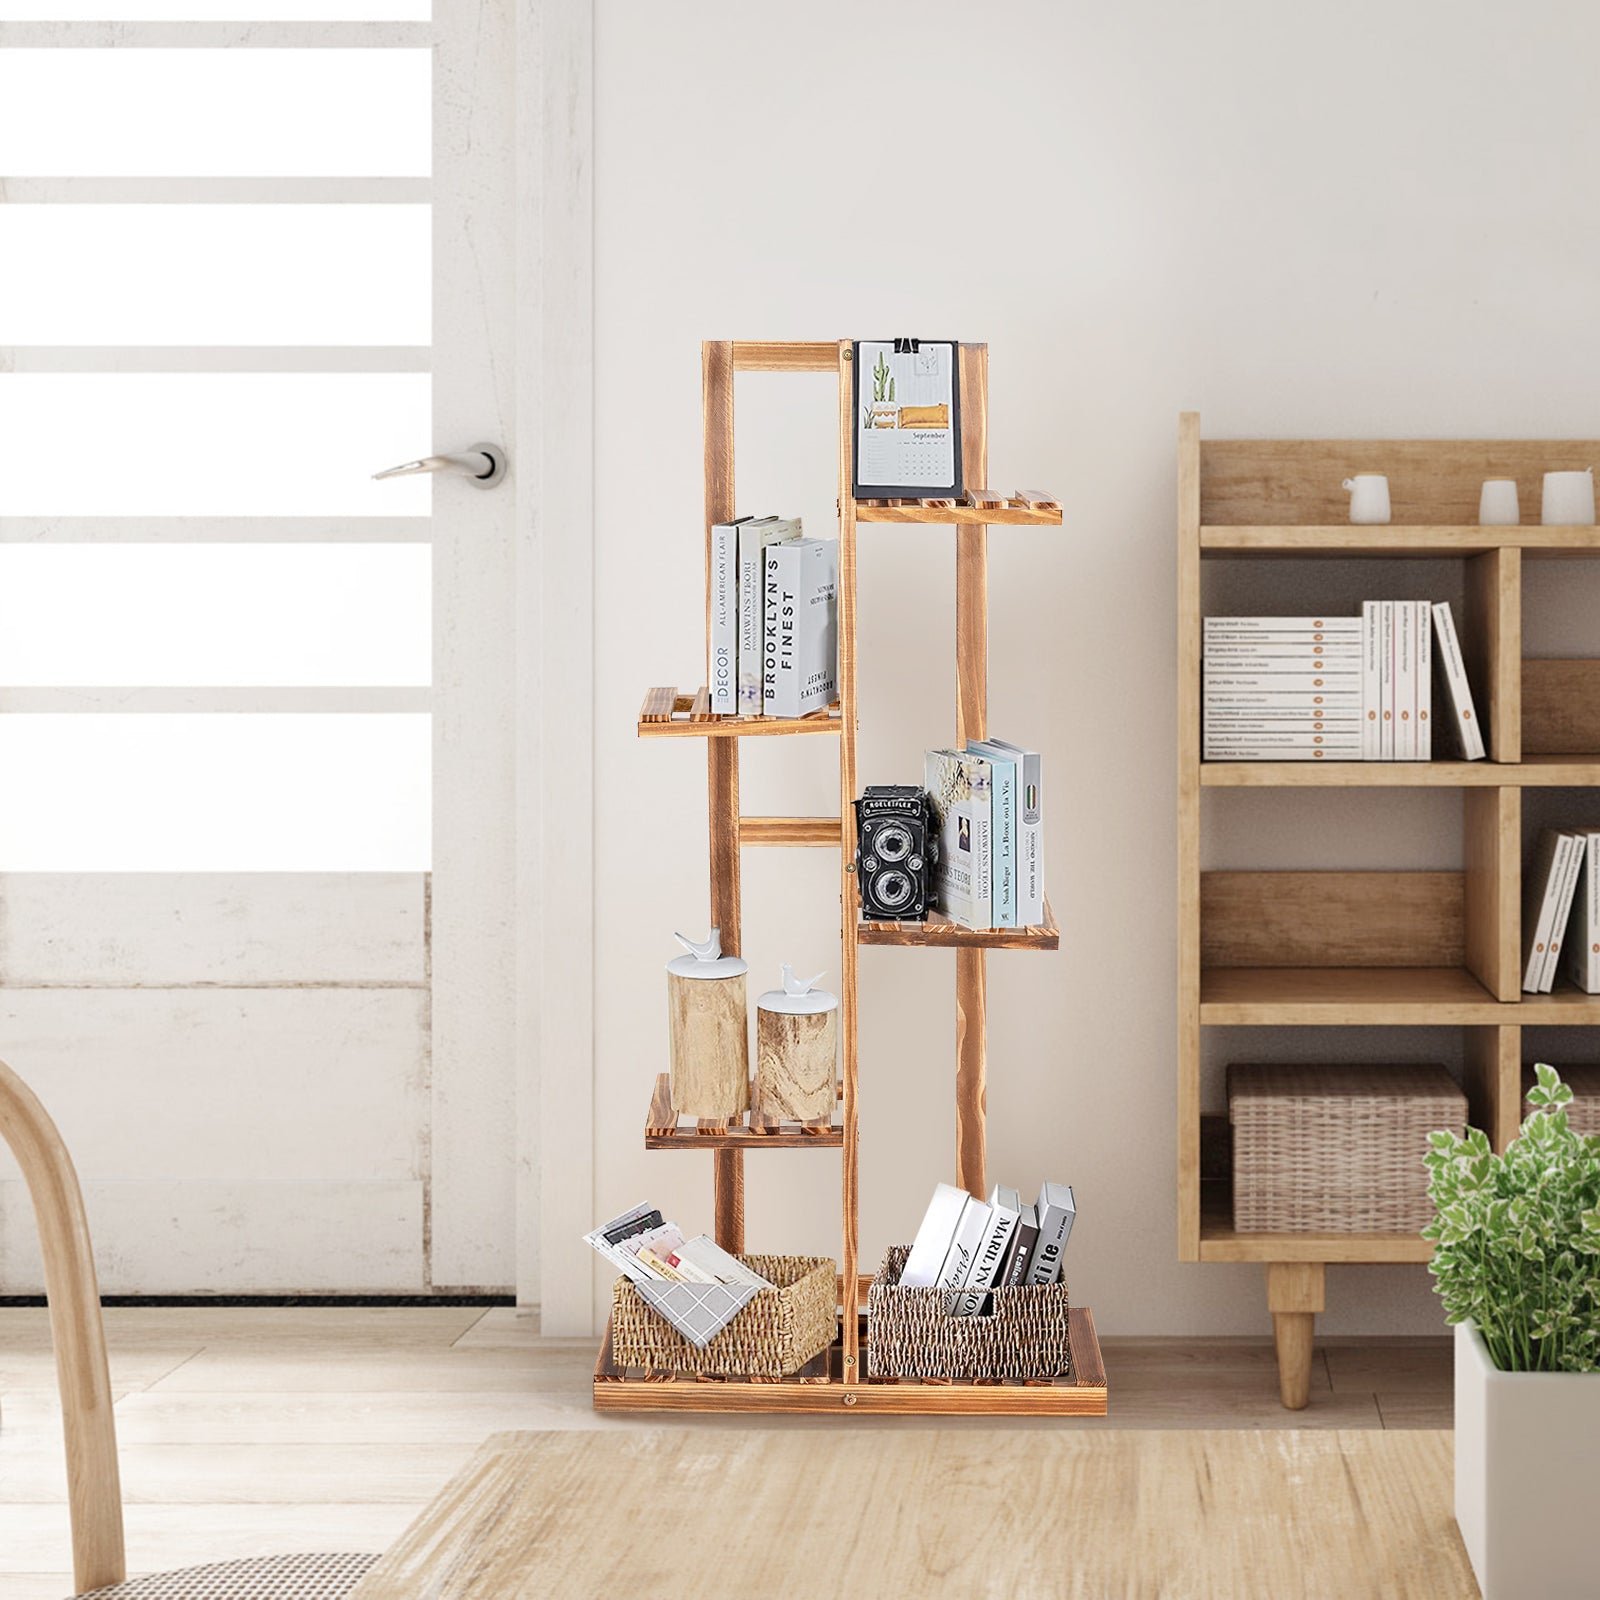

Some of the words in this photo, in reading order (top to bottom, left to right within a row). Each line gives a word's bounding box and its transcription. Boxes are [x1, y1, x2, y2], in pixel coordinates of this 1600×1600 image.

[743, 562, 751, 596] TEORI
[743, 599, 751, 651] DARWINS
[765, 559, 778, 699] BROOKLYN'S
[781, 591, 794, 670] FINEST
[717, 648, 728, 697] DECOR
[807, 671, 827, 685] FINEST
[1002, 780, 1010, 795] Vie
[1002, 797, 1010, 806] la
[1003, 807, 1010, 819] ou
[981, 821, 989, 867] DARWINS
[1002, 821, 1010, 843] Boxe
[1002, 848, 1010, 857] La
[981, 868, 989, 899] TEORI
[976, 1217, 1011, 1286] MARILYN
